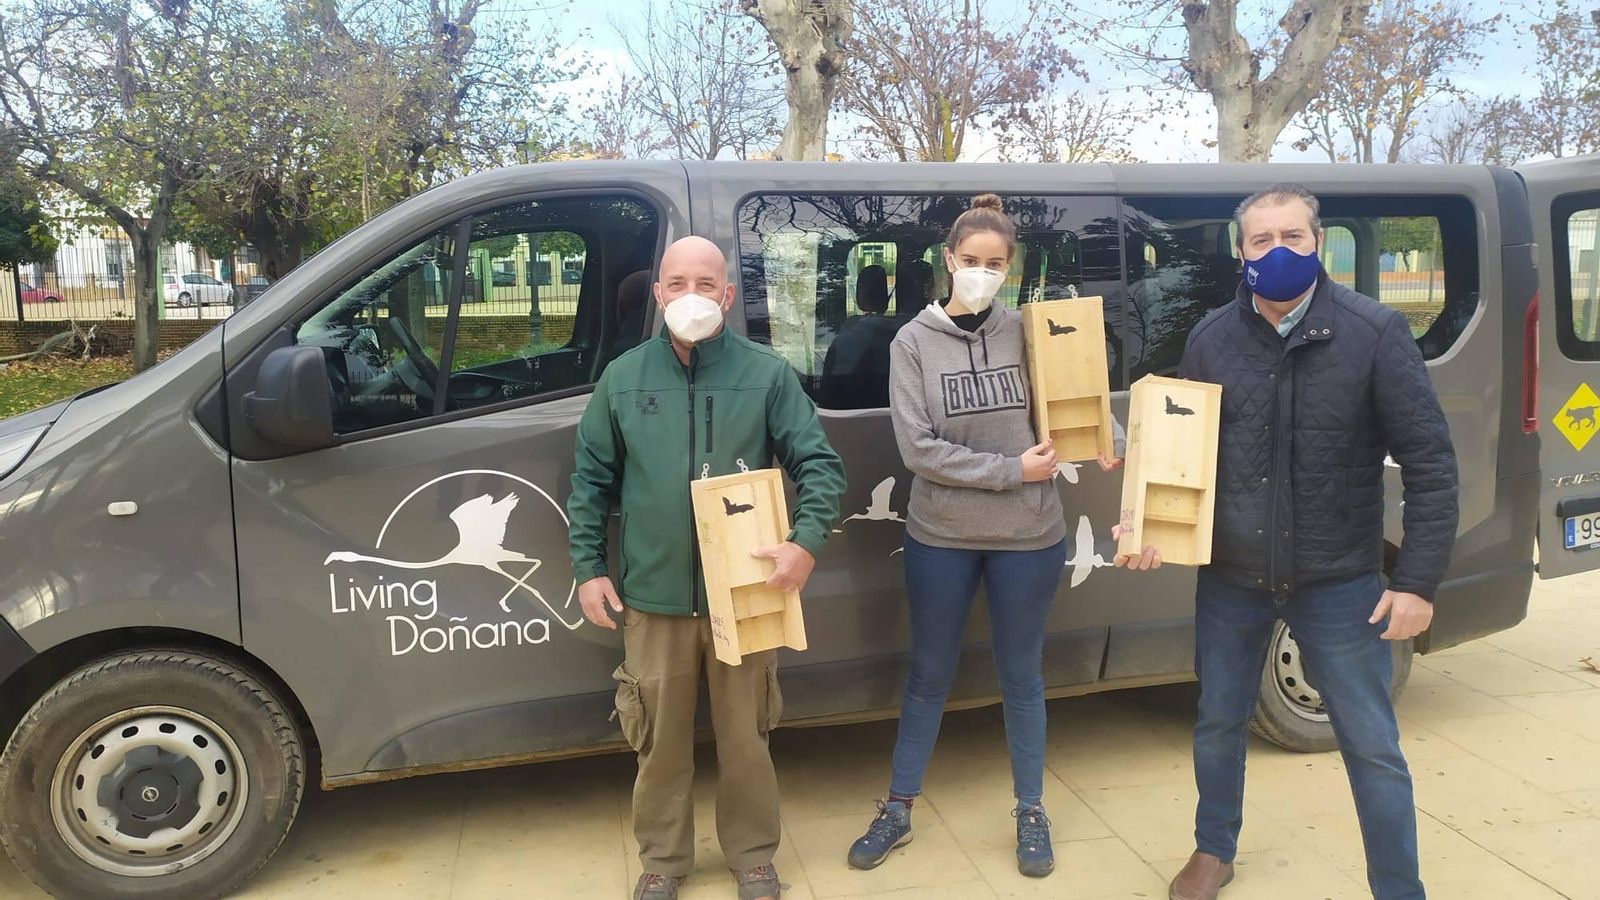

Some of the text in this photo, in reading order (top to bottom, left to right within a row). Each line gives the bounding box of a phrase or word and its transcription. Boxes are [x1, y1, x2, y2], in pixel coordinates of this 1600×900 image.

[947, 370, 1024, 411] BRUTAL
[329, 573, 438, 621] Living
[385, 615, 551, 656] Doñana
